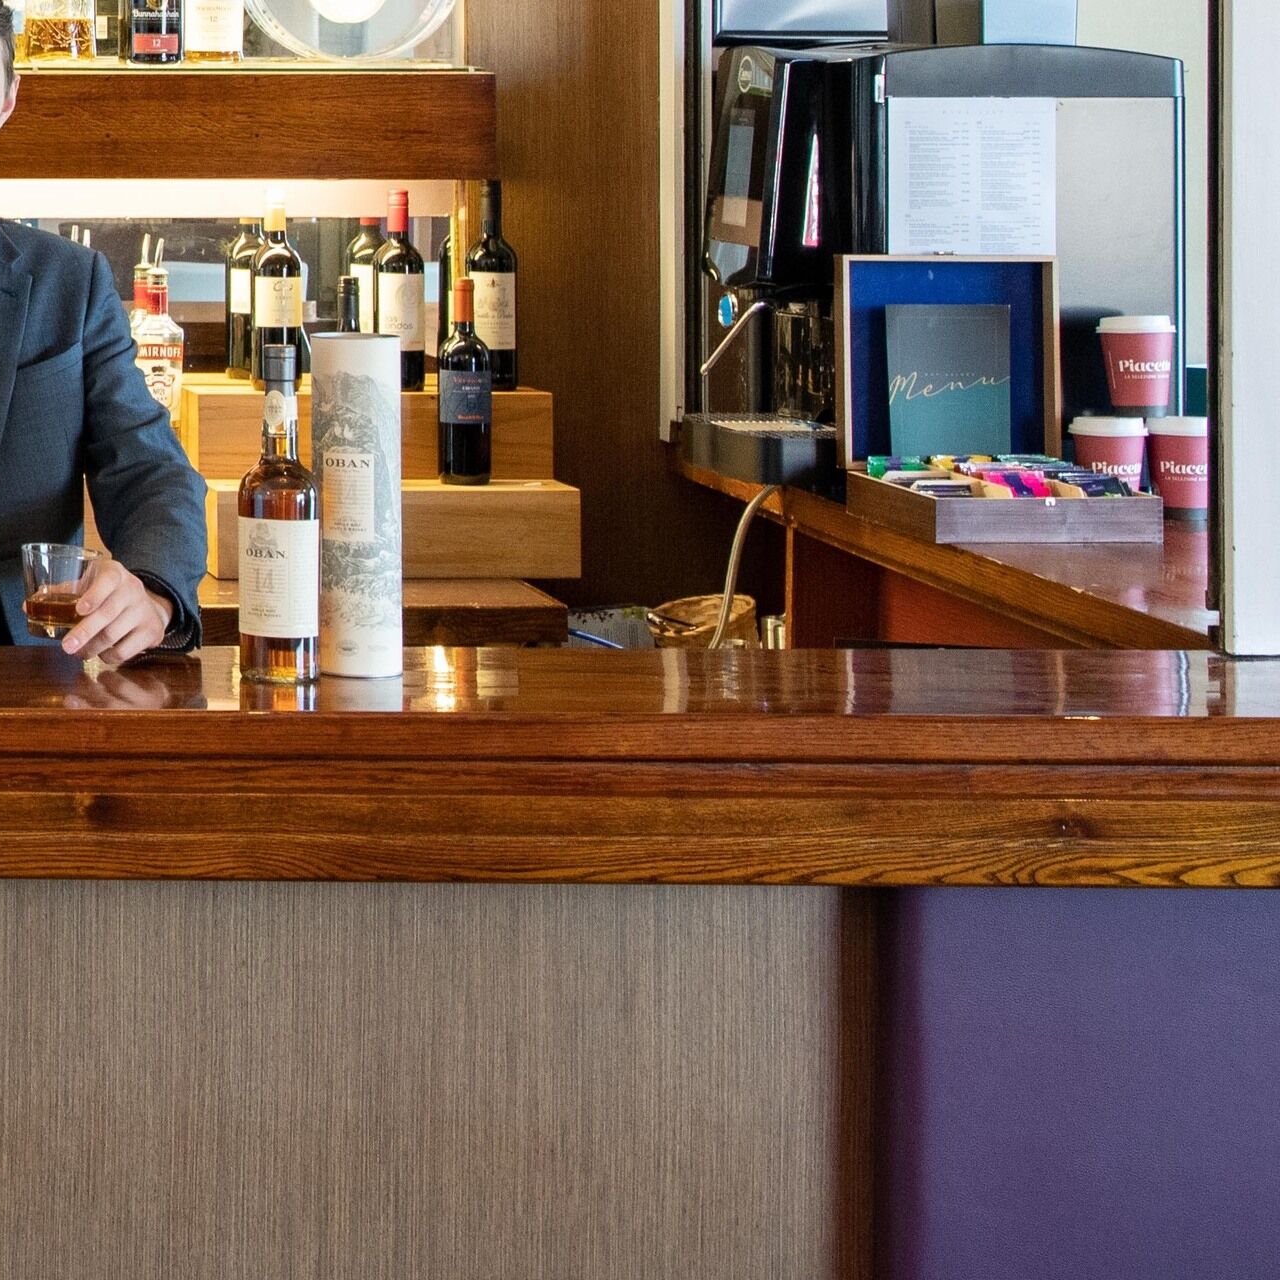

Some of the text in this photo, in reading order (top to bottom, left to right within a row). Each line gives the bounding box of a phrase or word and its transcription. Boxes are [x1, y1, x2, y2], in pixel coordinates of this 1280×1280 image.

[152, 39, 161, 47] 12
[889, 371, 1011, 406] Menu
[325, 457, 371, 468] OBAN
[245, 547, 288, 559] OBAN
